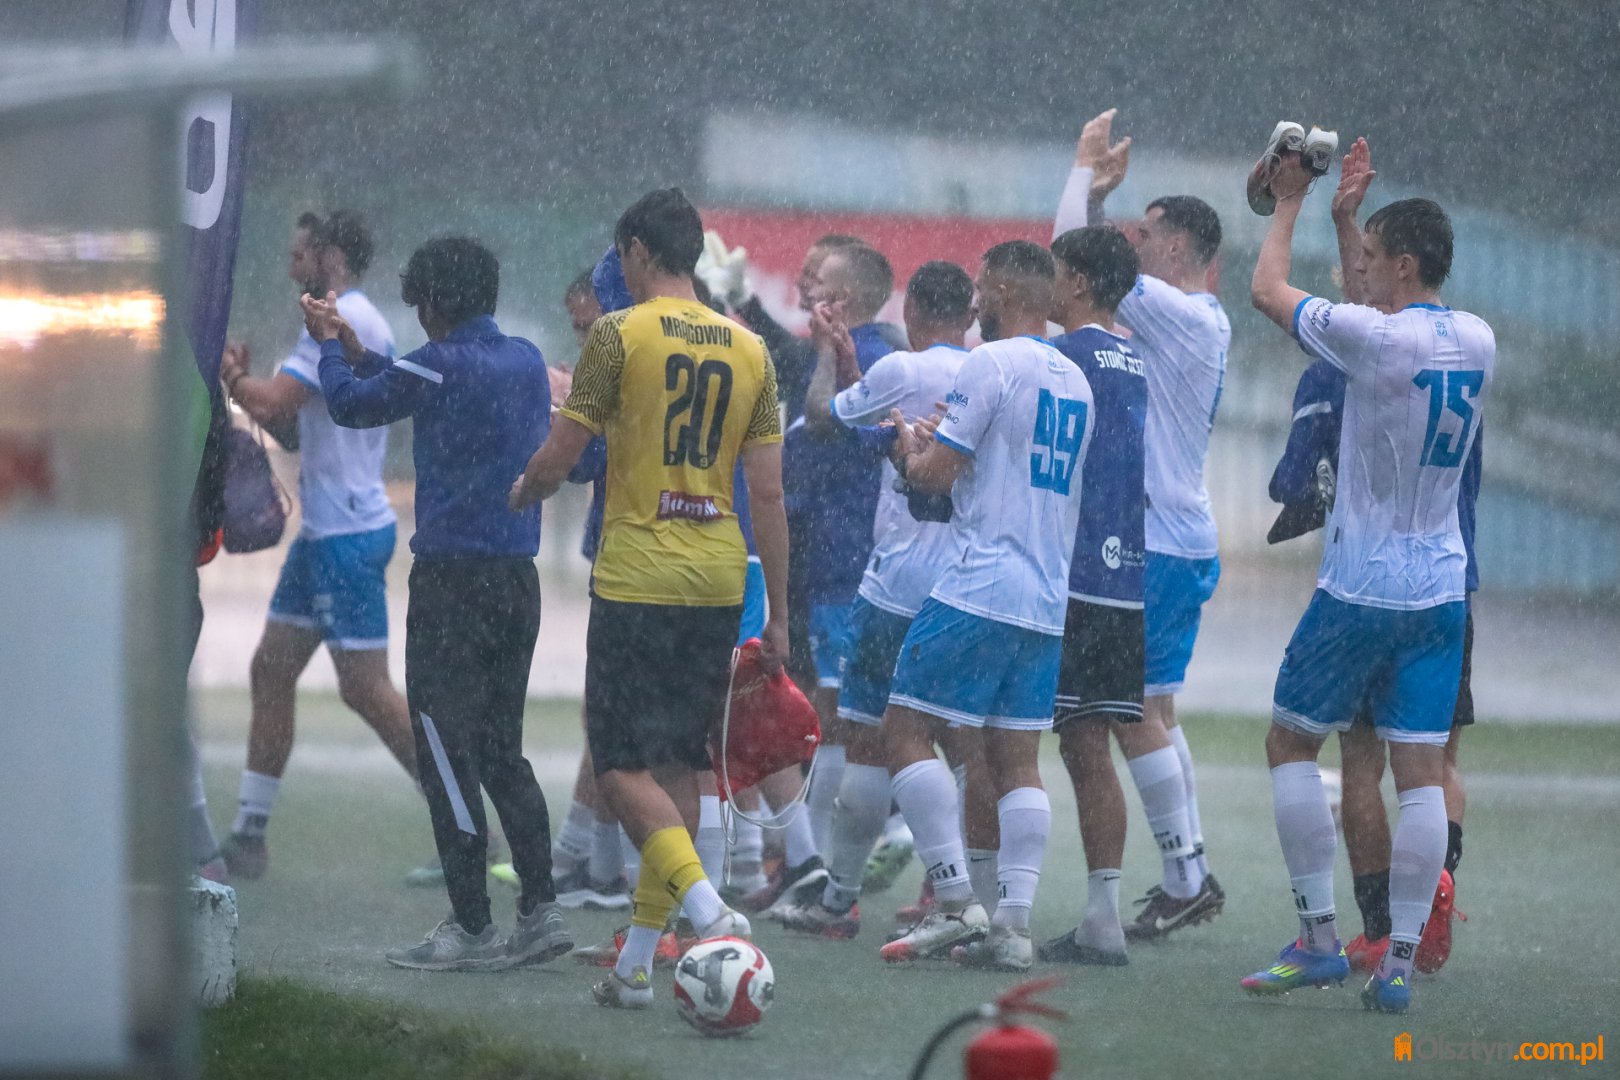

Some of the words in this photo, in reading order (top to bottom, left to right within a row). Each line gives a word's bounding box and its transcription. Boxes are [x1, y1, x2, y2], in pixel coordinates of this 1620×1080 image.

[664, 353, 733, 469] 20
[1030, 388, 1088, 496] 99
[1412, 369, 1485, 468] 15
[1394, 942, 1412, 957] FS
